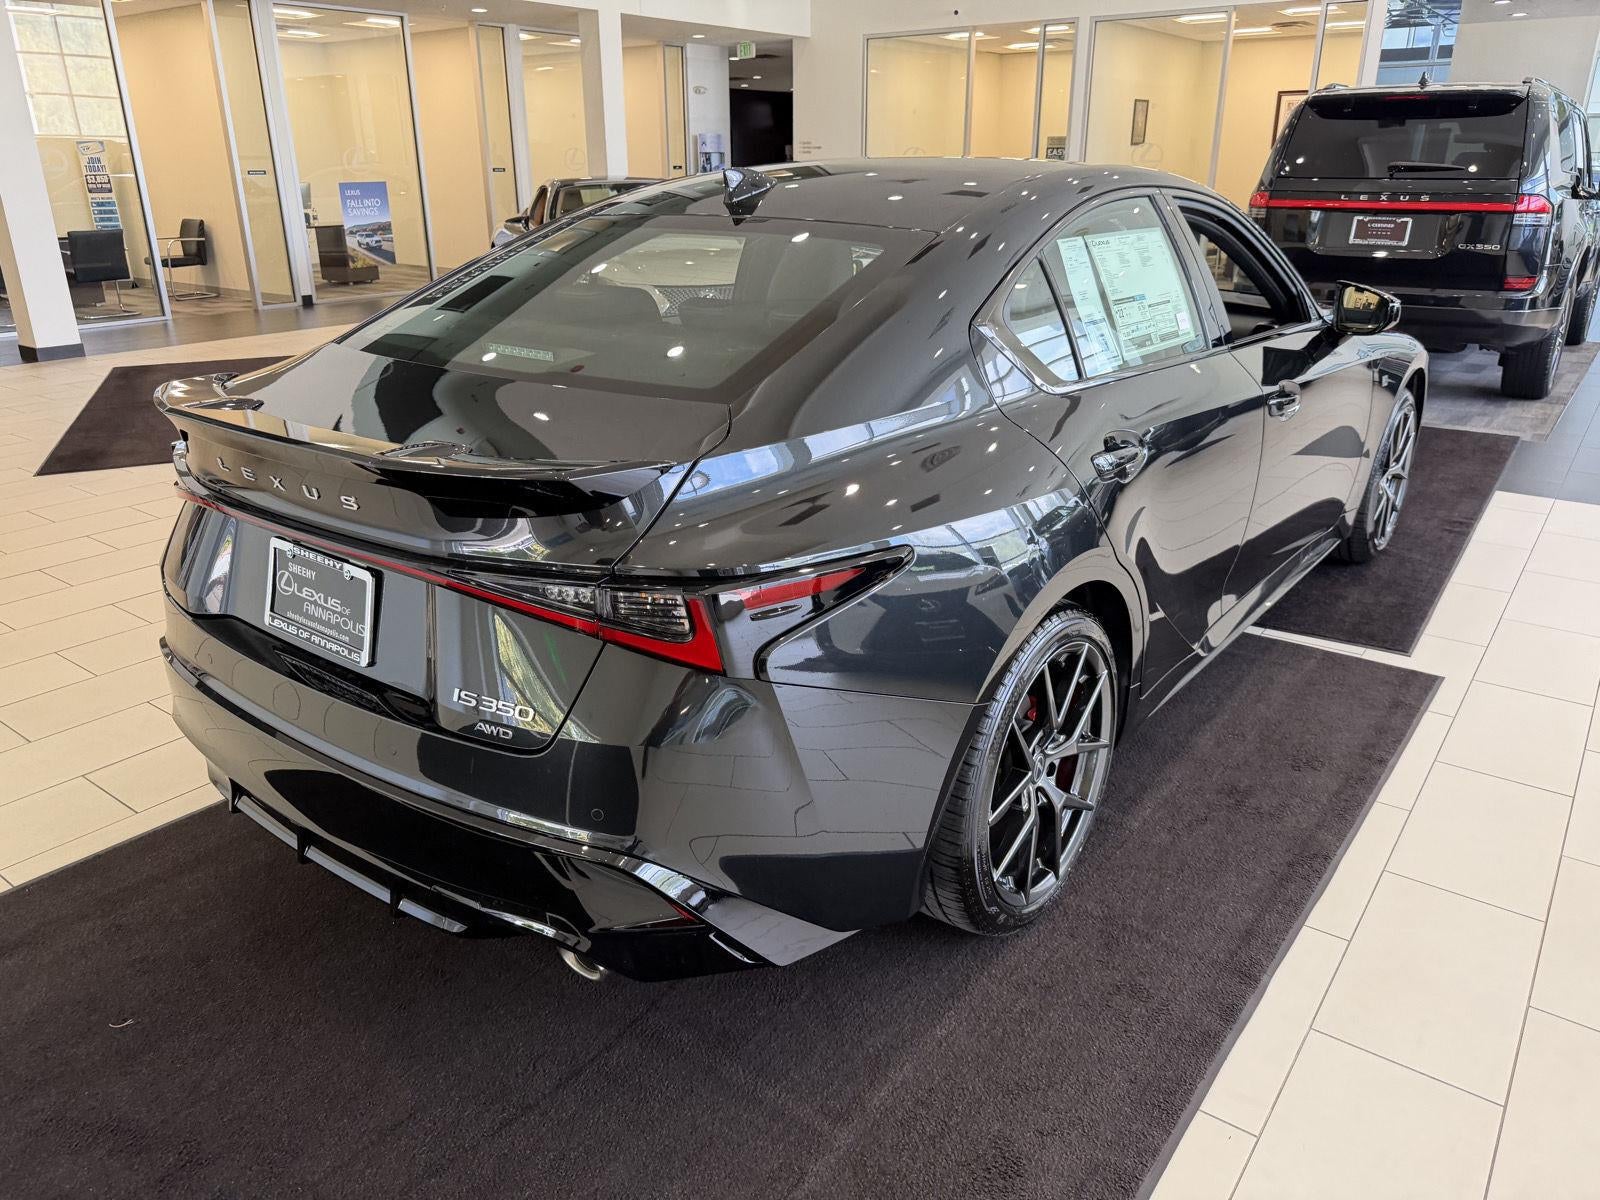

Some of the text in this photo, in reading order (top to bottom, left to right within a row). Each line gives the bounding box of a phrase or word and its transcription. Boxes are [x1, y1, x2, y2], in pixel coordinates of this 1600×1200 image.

[84, 164, 107, 173] TODAY!
[87, 156, 101, 164] JOIN
[347, 198, 381, 208] FALL INTO
[348, 208, 379, 216] SAVINGS
[216, 457, 360, 511] LEXUS
[292, 546, 342, 571] SHEEHY
[287, 561, 317, 581] SHEEHY
[294, 582, 351, 616] LEXUS OF
[303, 601, 367, 637] ANNAPOLIS
[269, 616, 361, 662] LEXUS OF ANNAPOLIS
[474, 722, 513, 740] AWD
